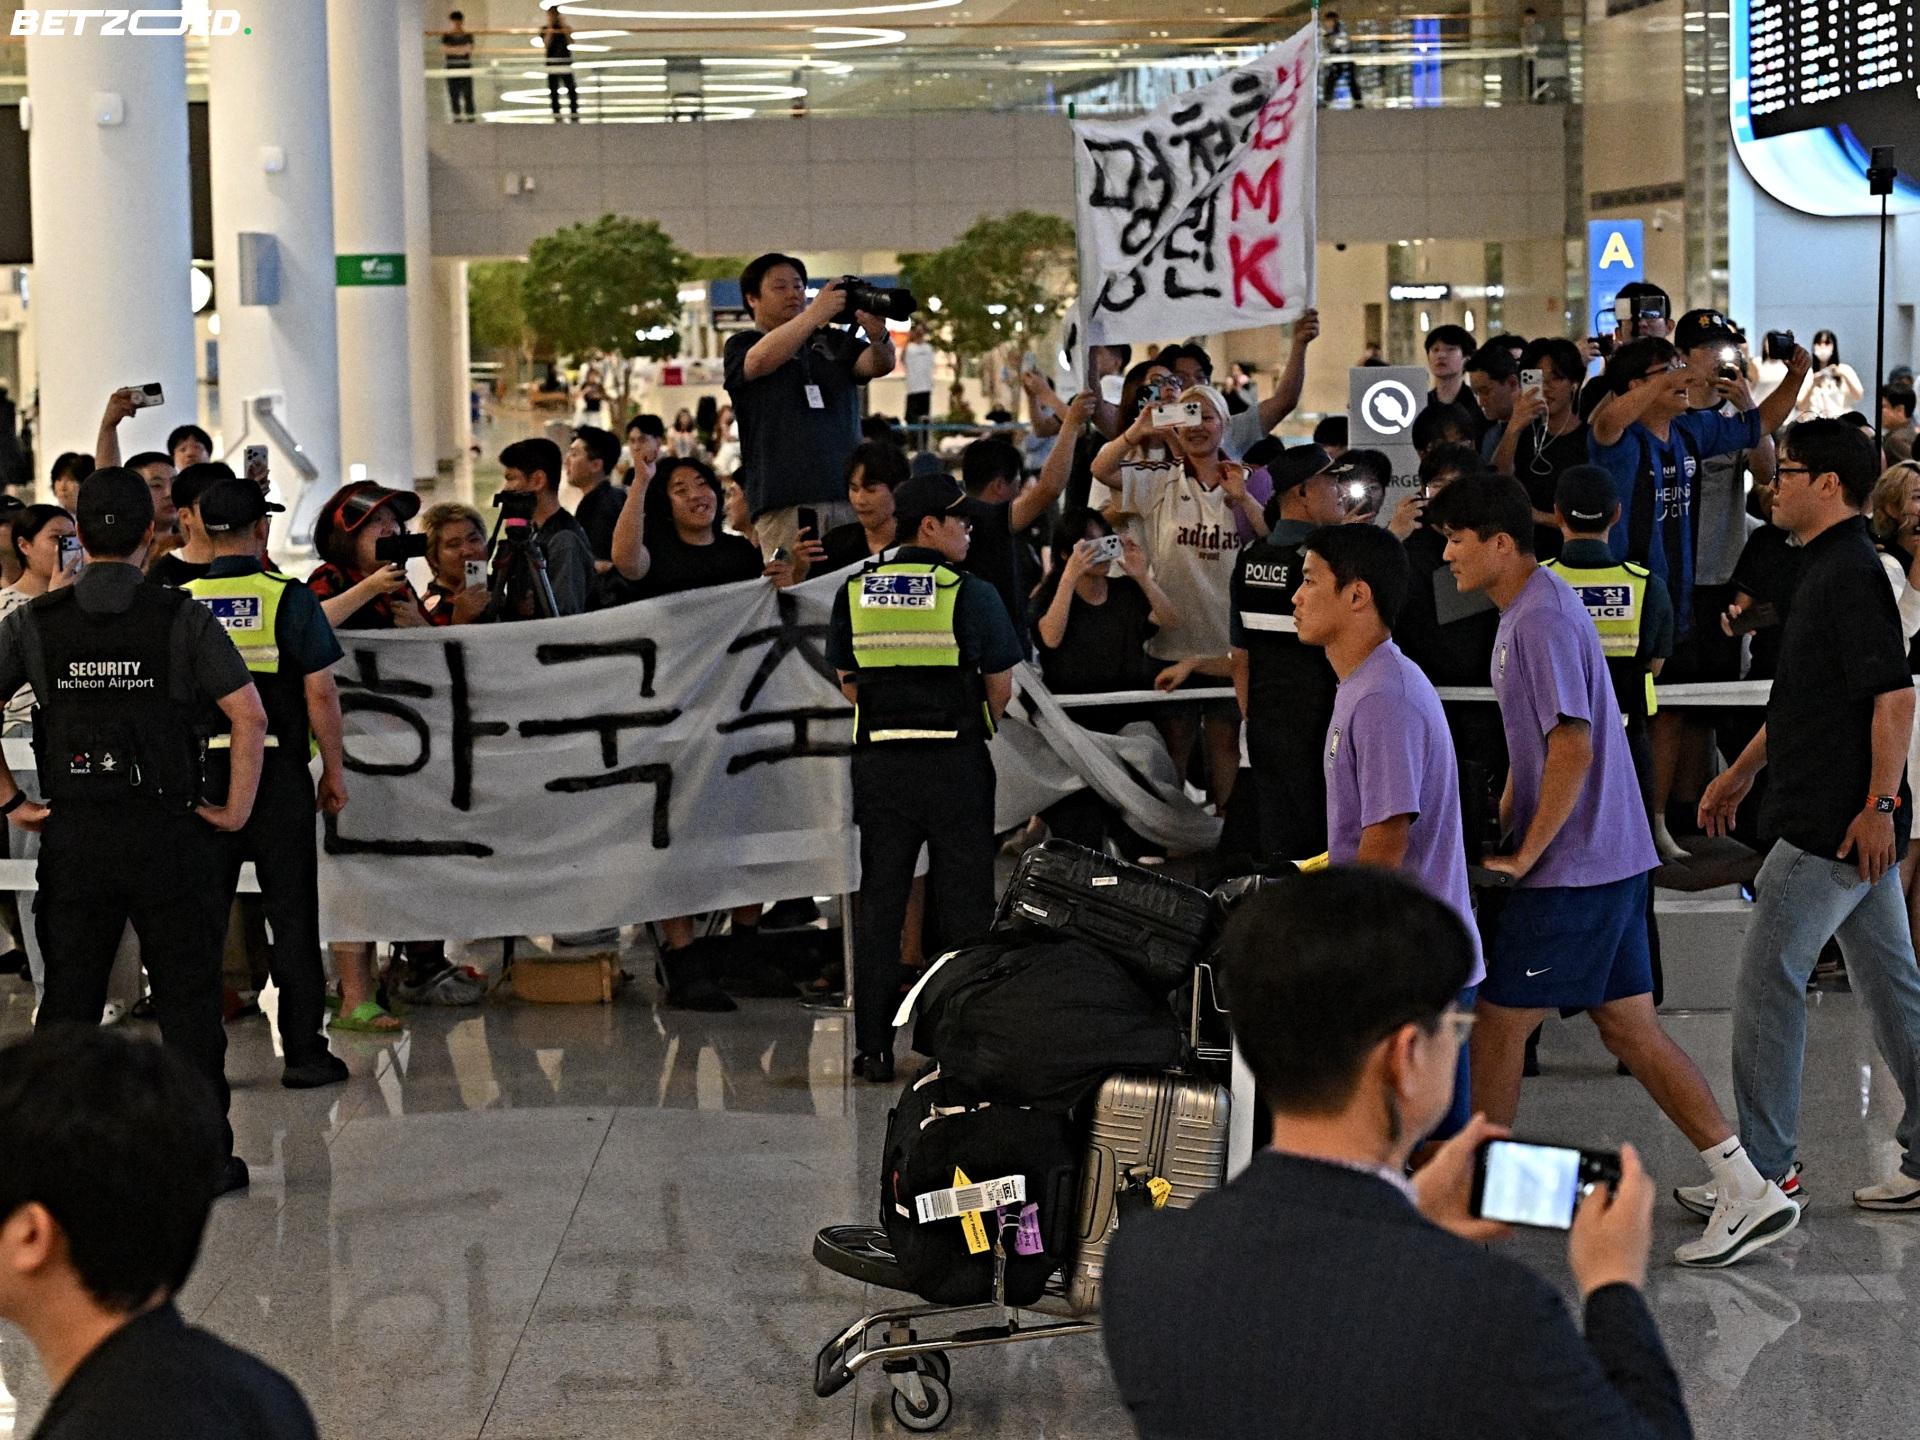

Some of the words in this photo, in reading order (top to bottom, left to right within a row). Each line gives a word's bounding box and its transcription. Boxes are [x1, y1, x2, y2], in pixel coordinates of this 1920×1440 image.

[1599, 231, 1635, 269] A
[1391, 474, 1420, 488] RGE
[1177, 523, 1240, 550] adidas
[1245, 563, 1288, 582] POLICE
[866, 577, 930, 594] 경찰
[867, 595, 927, 606] POLICE
[1588, 607, 1625, 617] LICE
[226, 618, 253, 628] ICE
[69, 661, 141, 677] SECURITY
[57, 677, 105, 690] Incheon
[108, 677, 155, 691] Airport
